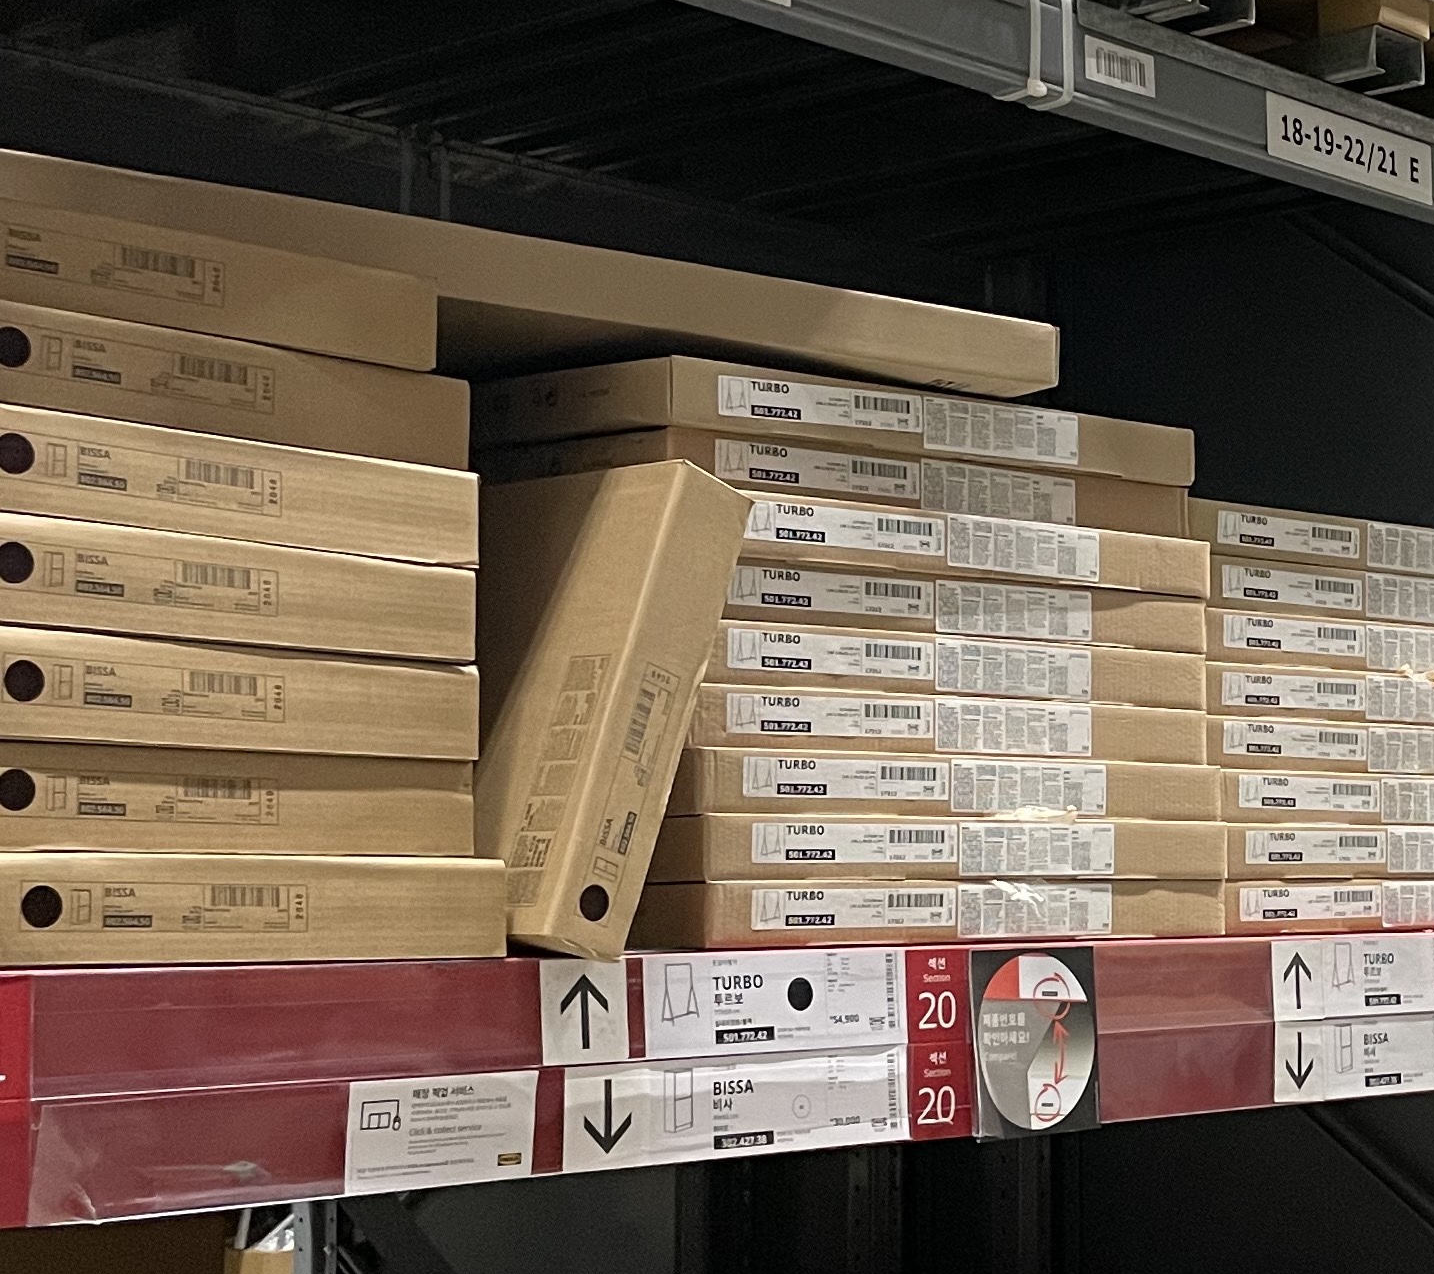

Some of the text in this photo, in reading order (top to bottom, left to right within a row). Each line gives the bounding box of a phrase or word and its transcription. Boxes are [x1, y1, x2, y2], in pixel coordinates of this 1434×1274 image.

[1281, 114, 1420, 184] 18-19-22/21 E
[74, 338, 107, 354] BISSA
[750, 380, 790, 395] TURBO
[79, 446, 112, 461] BISSA
[749, 444, 788, 458] TURBO
[776, 503, 815, 517] TURBO
[1240, 513, 1269, 526] TURBO
[76, 553, 110, 567] BISSA
[762, 569, 801, 582] TURBO
[1244, 567, 1272, 579] TURBO
[1246, 617, 1274, 629] TURBO
[762, 632, 801, 645] TURBO
[84, 664, 118, 678] BISSA
[1245, 675, 1273, 685] TURBO
[761, 696, 800, 708] TURBO
[1247, 723, 1275, 734] TURBO
[777, 759, 817, 771] TURBO
[79, 775, 111, 788] BISSA
[1262, 777, 1289, 788] TURBO
[786, 824, 825, 836] TURBO
[1269, 832, 1296, 842] TURBO
[103, 886, 137, 900] BISSA
[785, 890, 825, 902] TURBO
[1262, 888, 1290, 899] TURBO
[928, 957, 947, 970] 섹션
[1363, 952, 1395, 965] TURBO
[712, 974, 764, 991] TURBO
[922, 973, 951, 983] Section
[713, 992, 744, 1006] 투르보
[918, 990, 957, 1030] 20
[722, 1030, 768, 1043] 501.772.42
[1363, 1032, 1389, 1046] BISSA
[928, 1050, 947, 1065] 섹션
[923, 1068, 952, 1078] Section
[713, 1079, 755, 1096] BISSA
[712, 1098, 733, 1112] 비사
[917, 1085, 957, 1126] 20
